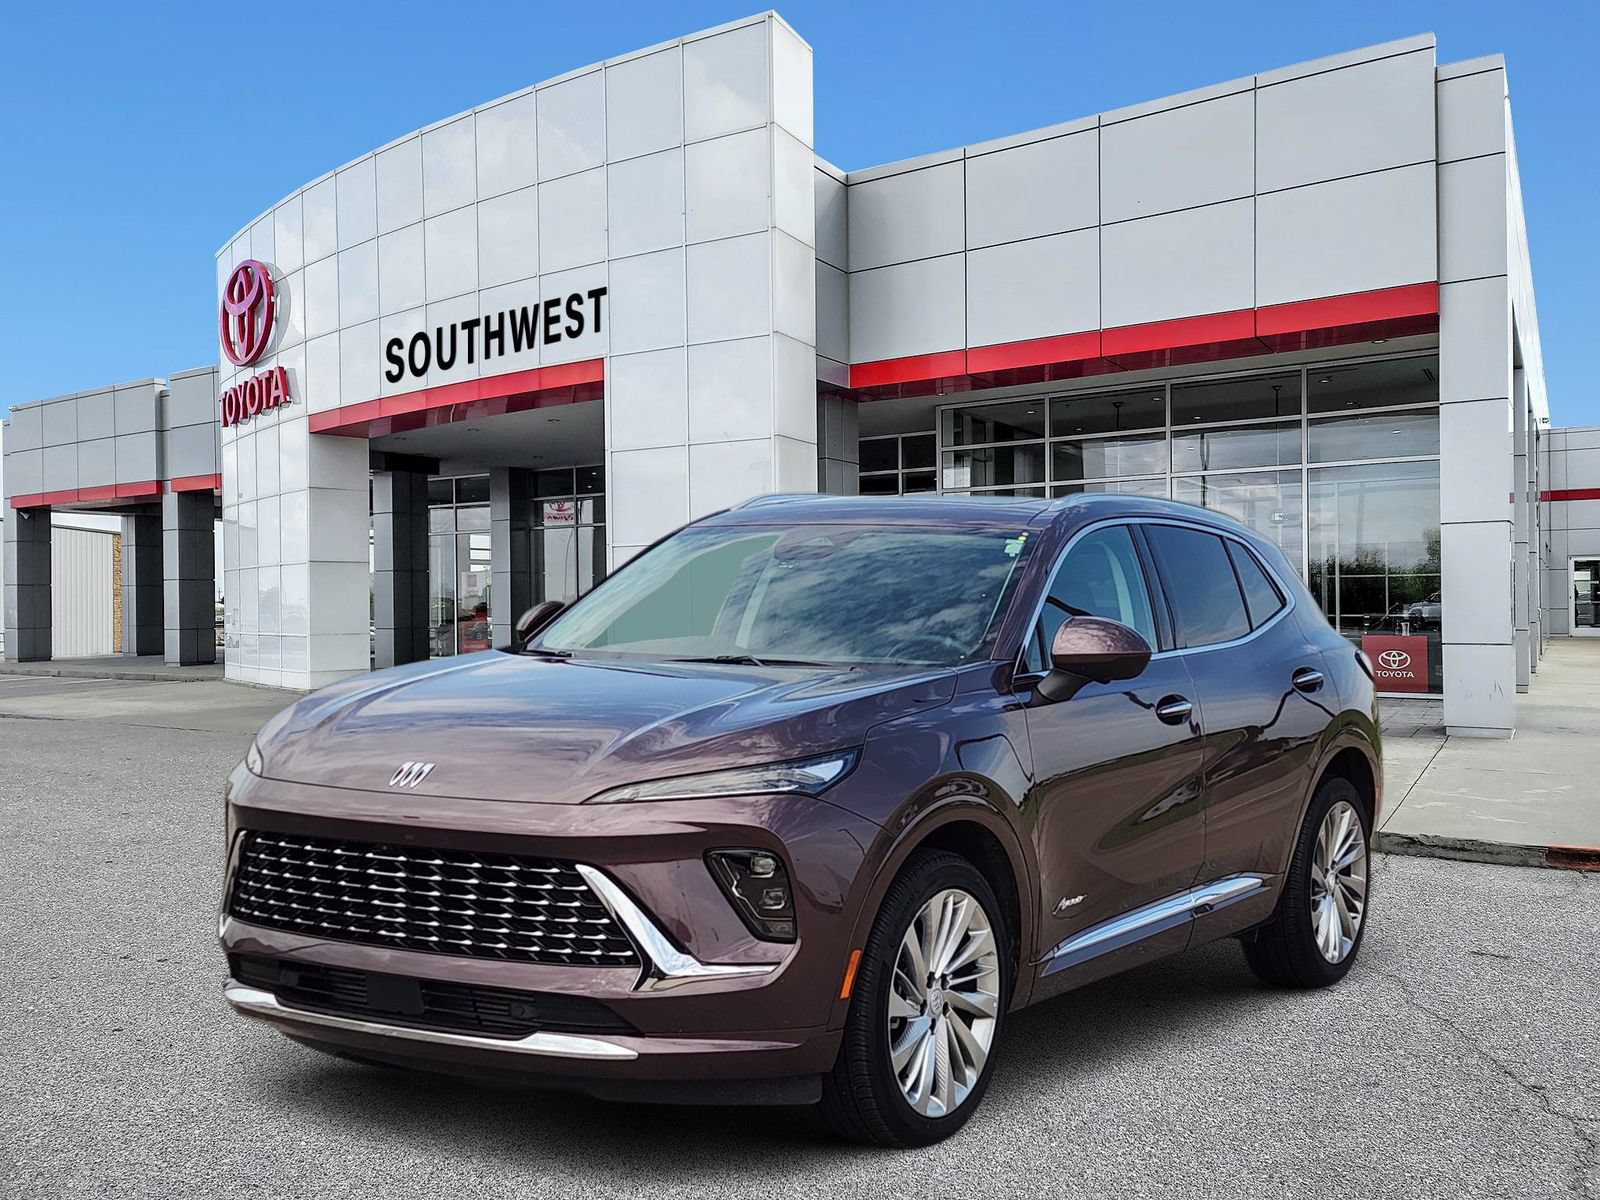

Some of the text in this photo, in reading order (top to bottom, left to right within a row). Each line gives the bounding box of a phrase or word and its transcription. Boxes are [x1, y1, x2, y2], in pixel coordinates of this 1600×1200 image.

[384, 286, 608, 384] SOUTHWEST
[219, 366, 291, 428] TOYOTA
[1375, 670, 1415, 678] TOYOTA
